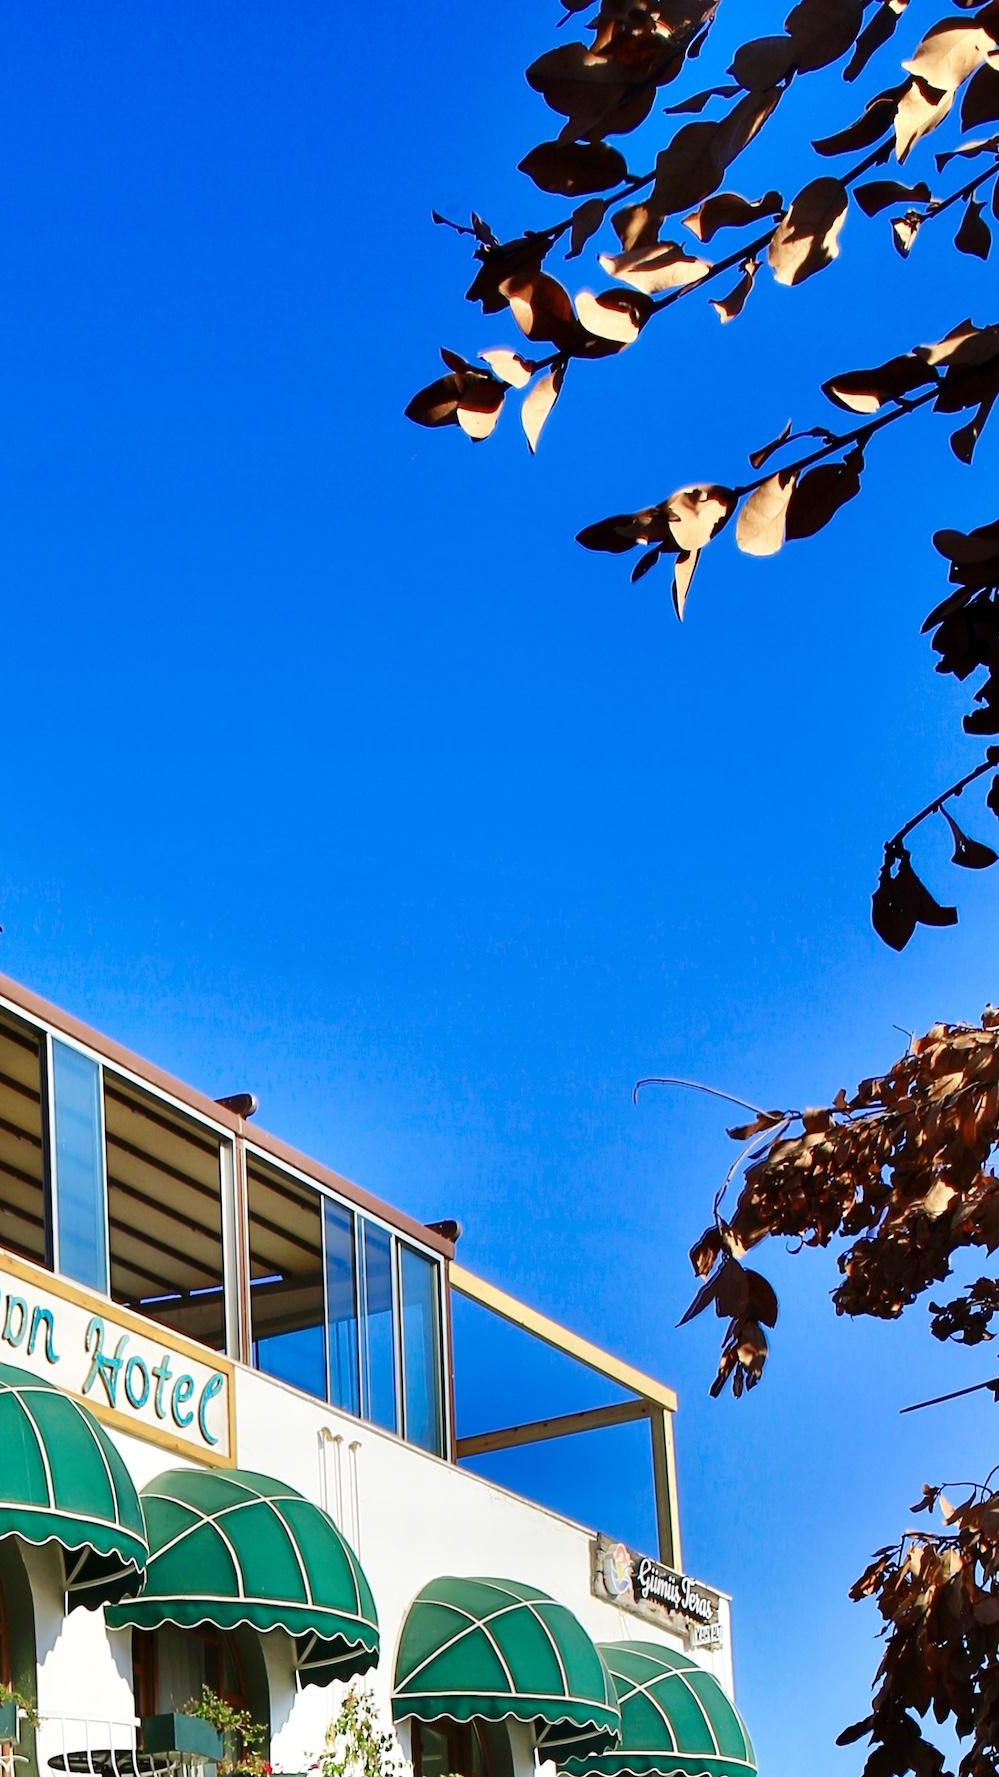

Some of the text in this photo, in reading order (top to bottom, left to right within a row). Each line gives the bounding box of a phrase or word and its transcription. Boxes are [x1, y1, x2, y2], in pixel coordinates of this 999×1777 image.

[81, 1315, 224, 1446] Hotel
[638, 1558, 713, 1619] Gümüş Teras
